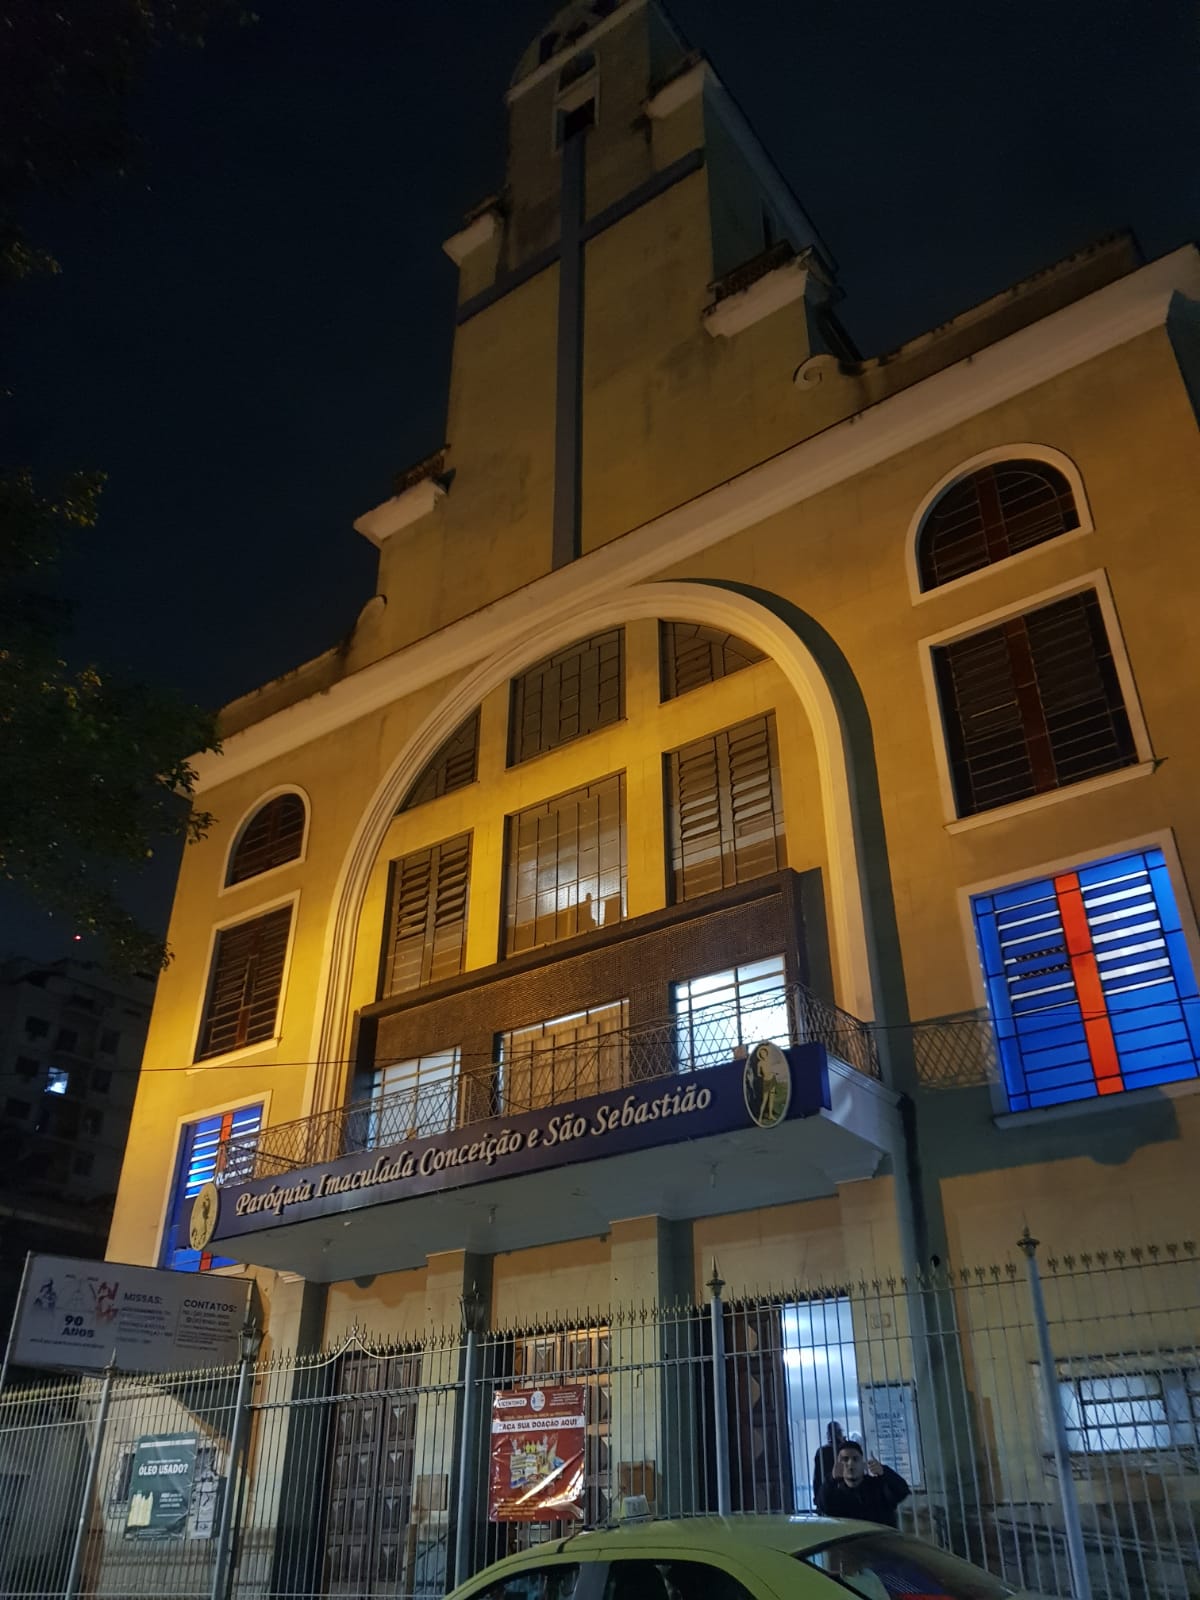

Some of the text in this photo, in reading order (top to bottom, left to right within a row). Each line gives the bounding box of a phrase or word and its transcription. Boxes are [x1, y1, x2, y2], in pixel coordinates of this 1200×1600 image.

[236, 1083, 711, 1215] Paróquia Imaculada Conceição e São Sebastião
[184, 1299, 238, 1312] CONTATOS:
[65, 1315, 84, 1326] 90
[62, 1327, 95, 1338] ANOS
[517, 1421, 531, 1429] SUA
[532, 1418, 559, 1428] DOAÇÃO
[561, 1417, 577, 1427] AQUI
[138, 1463, 188, 1476] ÓLEO USADO?
